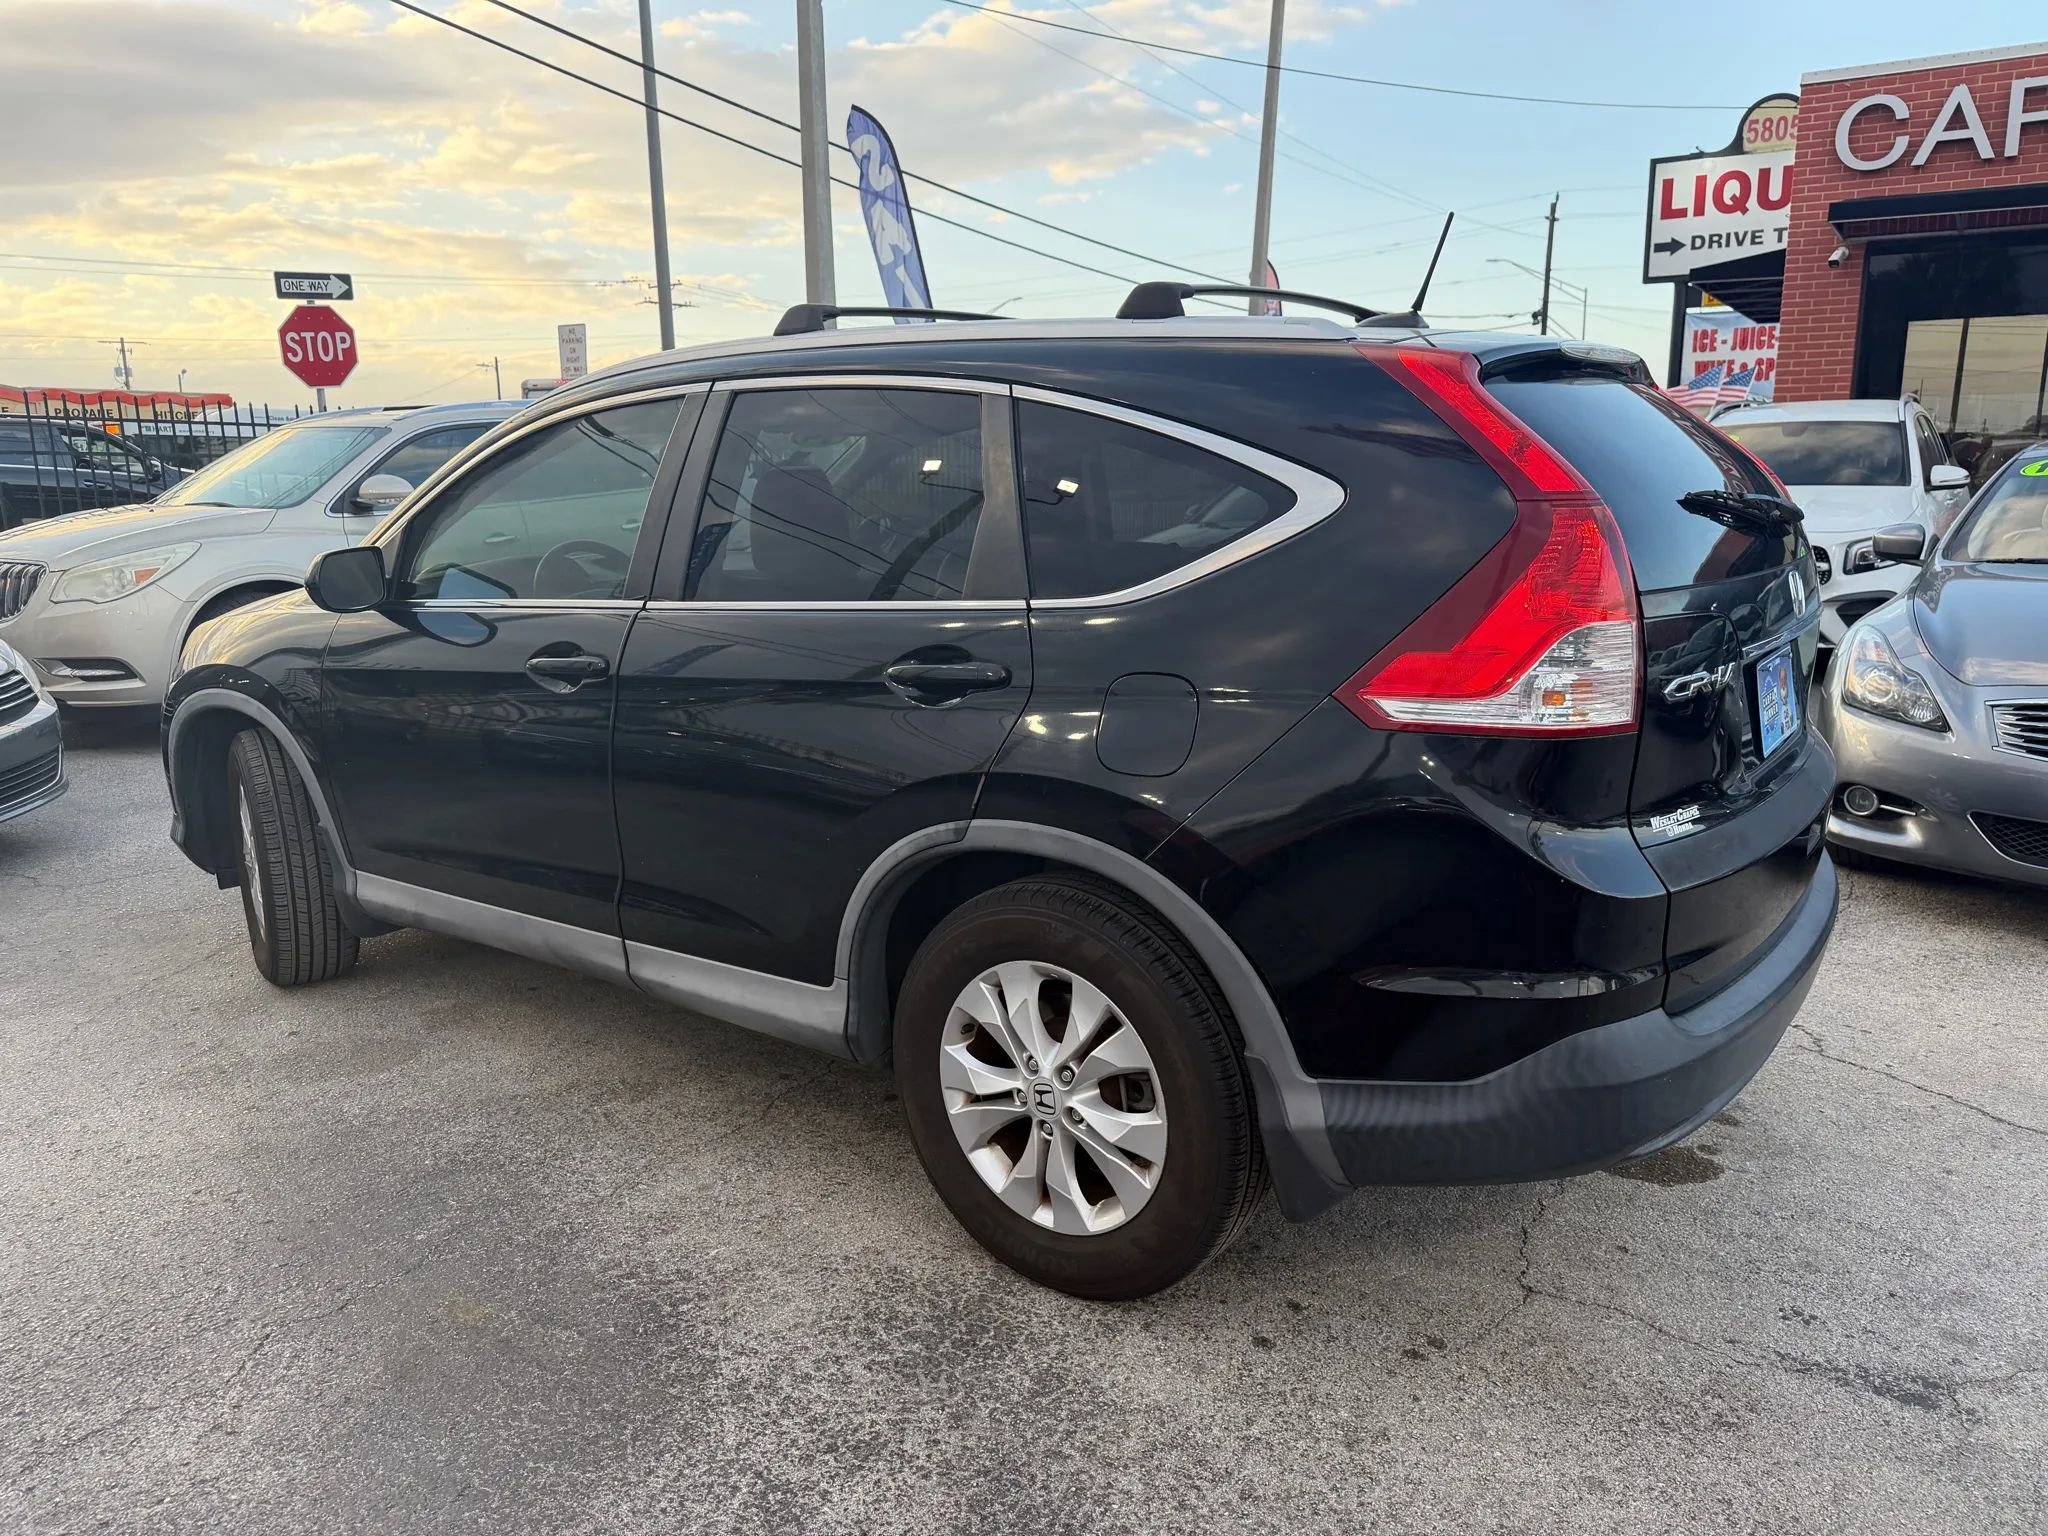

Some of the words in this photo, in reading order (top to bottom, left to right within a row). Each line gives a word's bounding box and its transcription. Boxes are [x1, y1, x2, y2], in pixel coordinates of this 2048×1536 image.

[1690, 229, 1764, 251] DRIVE
[283, 280, 306, 291] ONE
[308, 281, 329, 291] WAY
[285, 331, 351, 363] STOP
[561, 336, 583, 344] PARKING
[1692, 329, 1718, 353] ICE
[1730, 326, 1777, 351] JUICE
